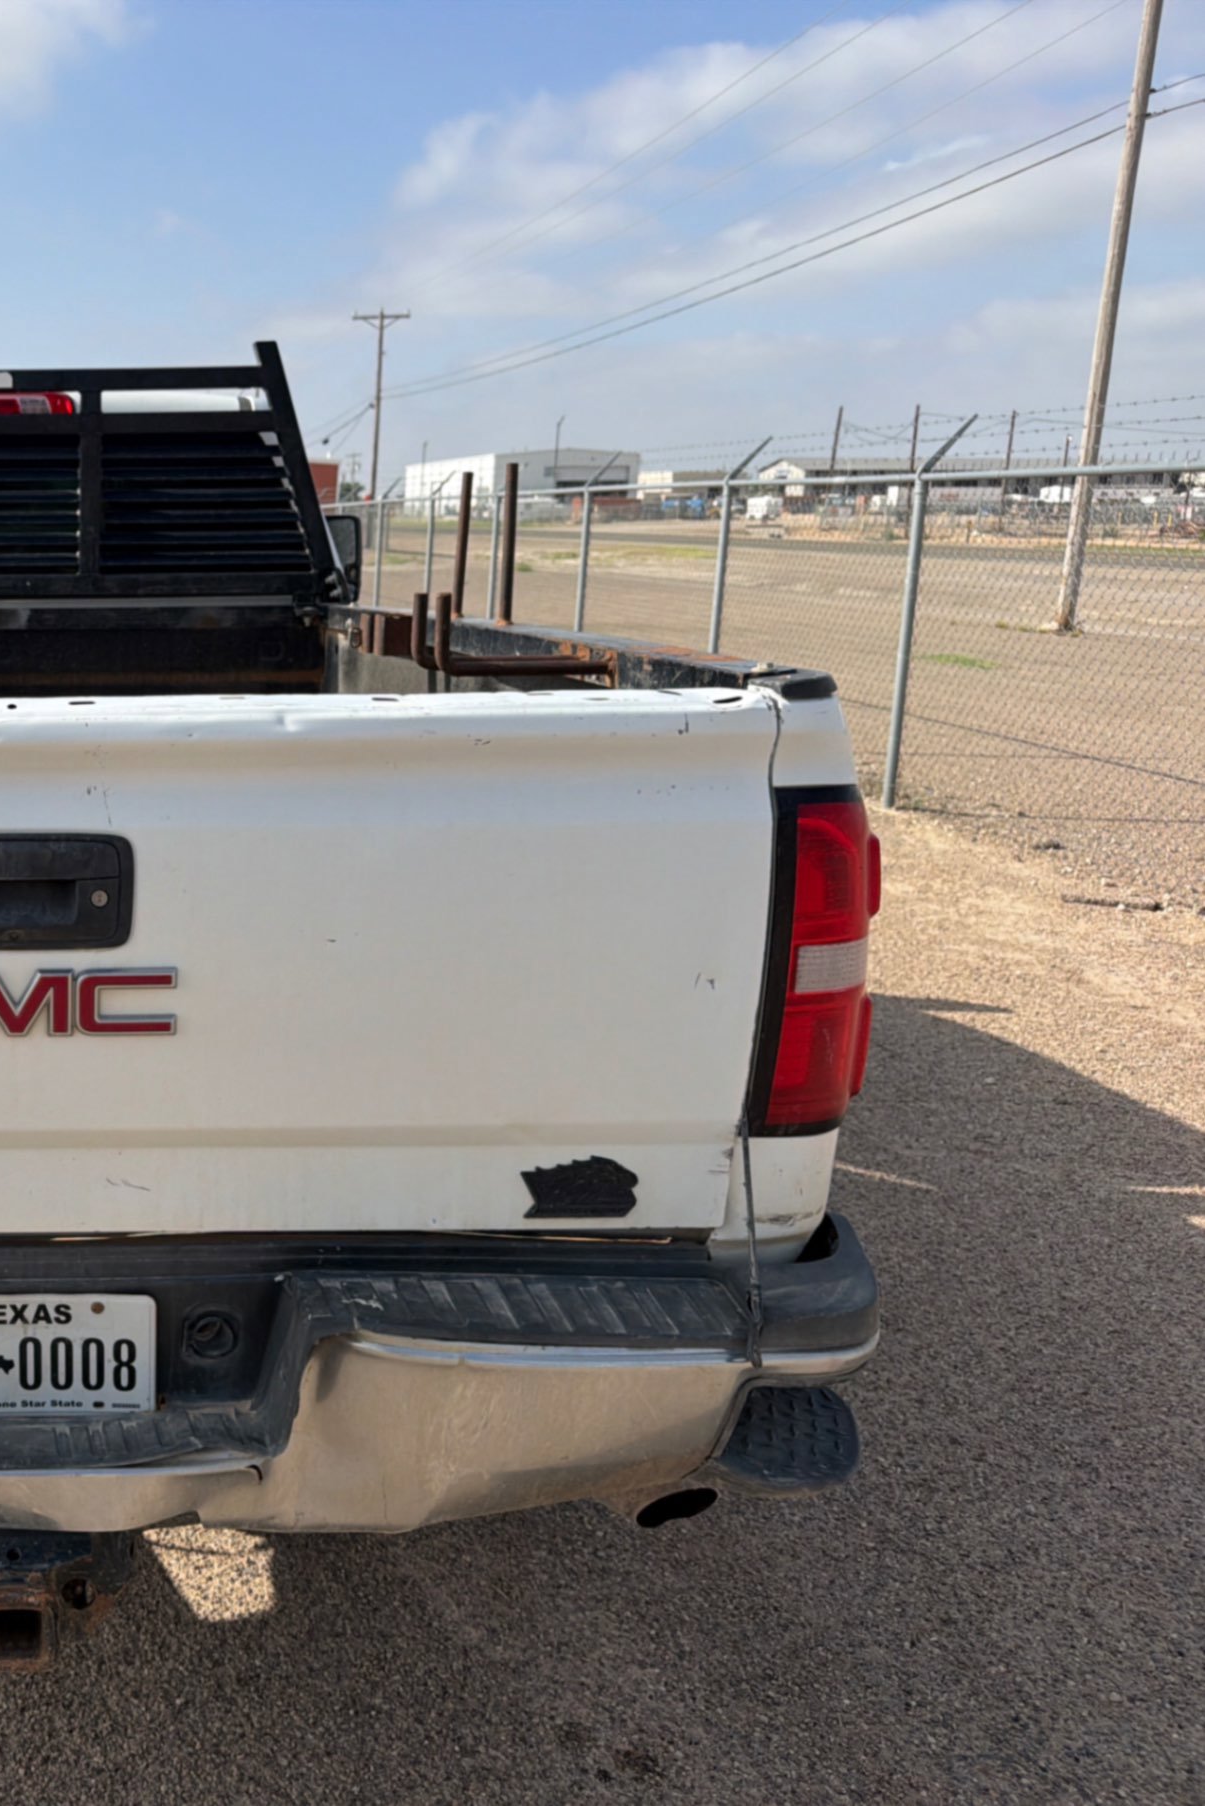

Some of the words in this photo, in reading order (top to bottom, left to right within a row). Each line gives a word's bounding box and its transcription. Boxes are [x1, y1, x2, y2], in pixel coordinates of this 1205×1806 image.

[18, 1336, 137, 1393] 0008
[20, 1399, 47, 1408] Star
[51, 1399, 84, 1408] State
